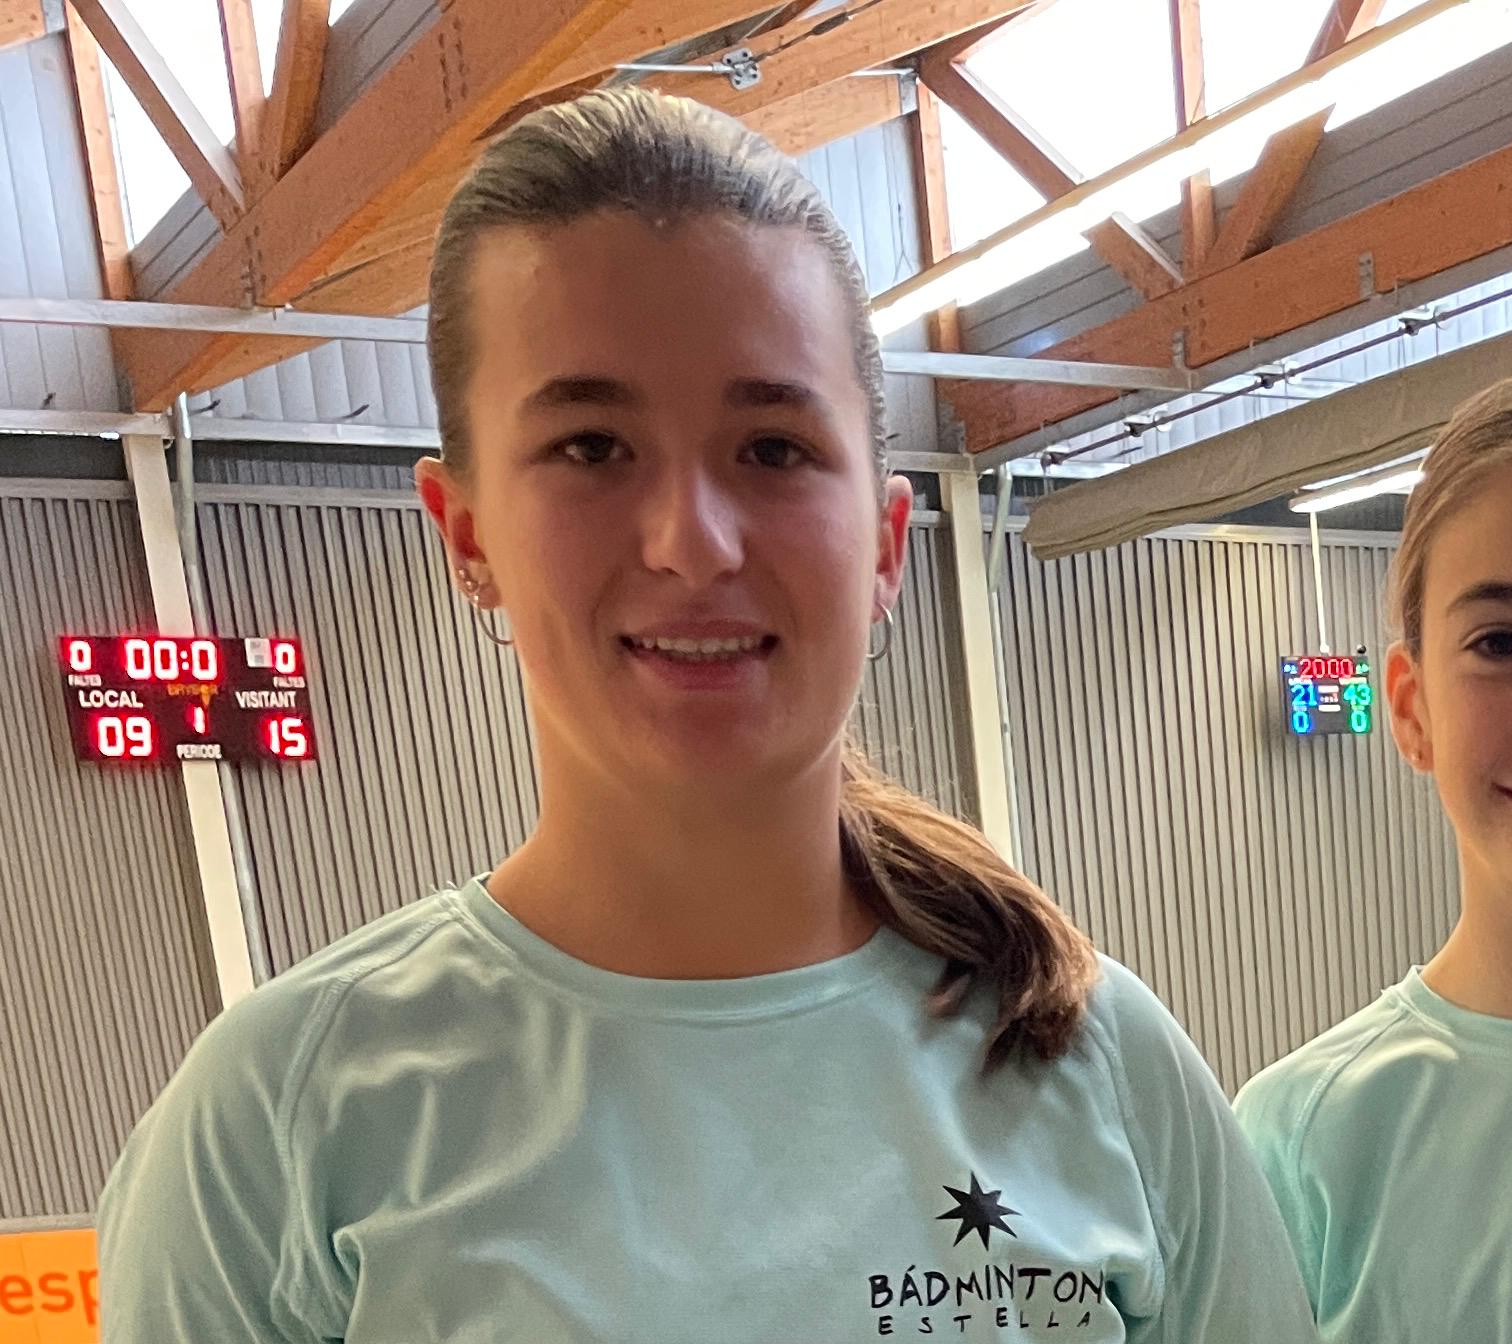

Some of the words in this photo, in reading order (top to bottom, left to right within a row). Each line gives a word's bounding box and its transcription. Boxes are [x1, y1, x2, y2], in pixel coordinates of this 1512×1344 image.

[69, 640, 92, 672] 0
[274, 642, 296, 674] 0
[78, 690, 144, 708] LOCAL
[235, 690, 297, 709] VISITANT
[1290, 684, 1318, 707] 21
[1343, 684, 1372, 706] 43
[1292, 711, 1310, 733] 0
[1350, 710, 1367, 733] 0
[98, 716, 153, 757] 09
[269, 717, 307, 757] 15
[868, 1263, 1105, 1309] BÁDMINTON
[878, 1307, 1091, 1335] ESTELLA
